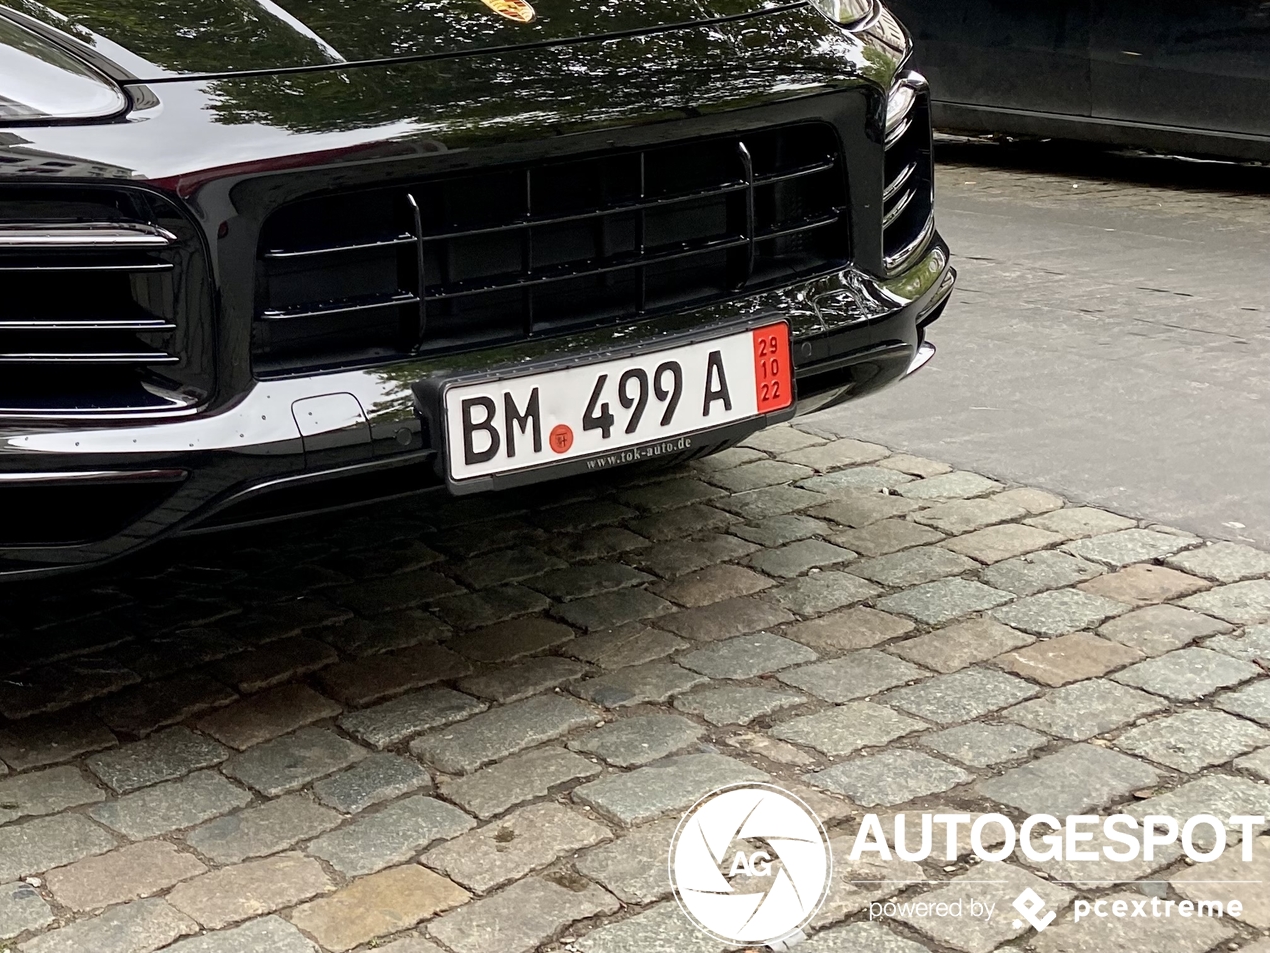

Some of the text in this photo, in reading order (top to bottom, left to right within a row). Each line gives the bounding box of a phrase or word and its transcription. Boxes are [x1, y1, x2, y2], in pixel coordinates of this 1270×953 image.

[758, 336, 778, 358] 29
[760, 358, 779, 380] 10
[761, 380, 781, 403] 22
[461, 350, 733, 466] BM 499 A
[586, 437, 691, 469] www.tok-auto.de
